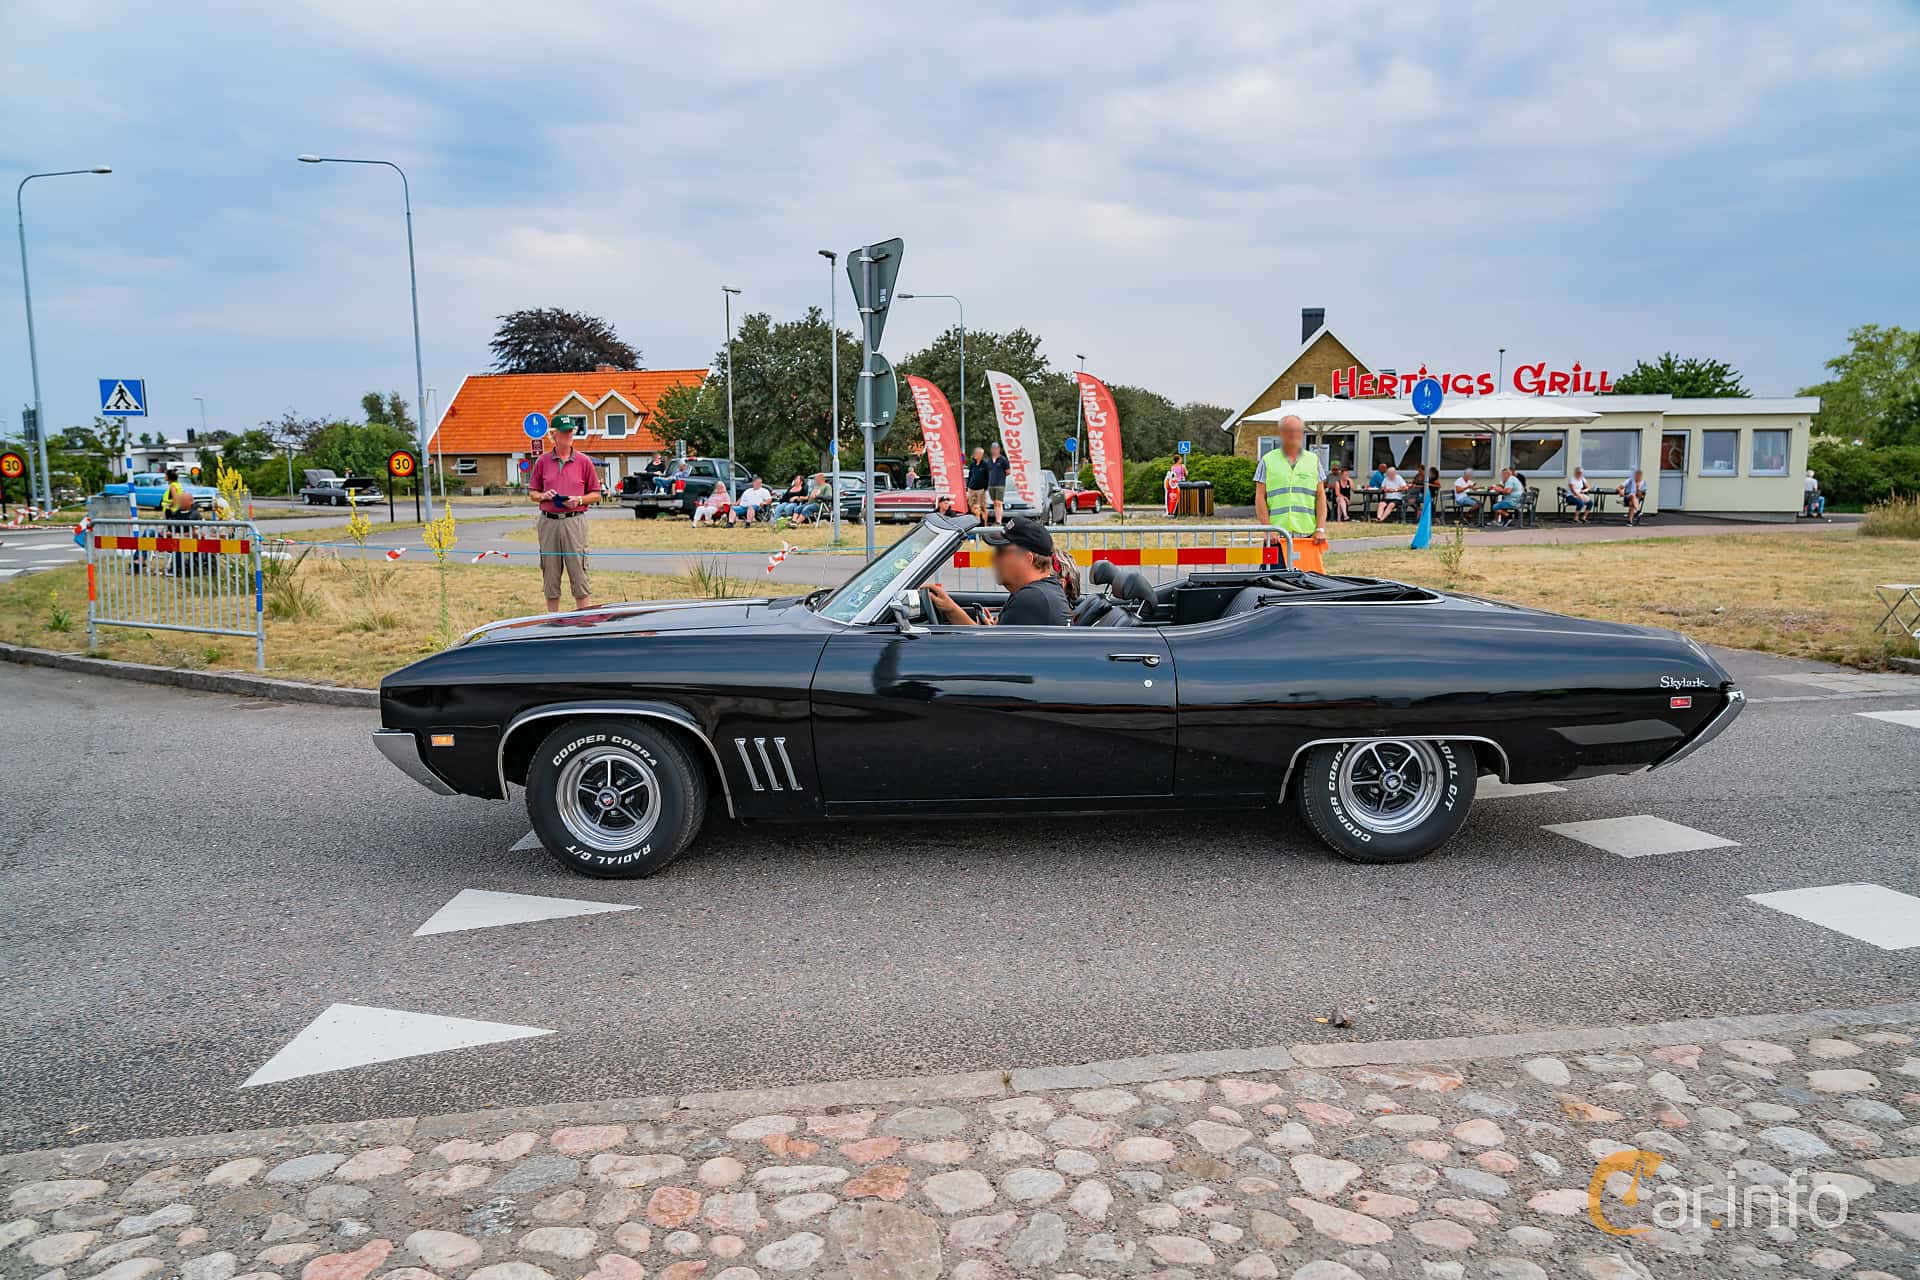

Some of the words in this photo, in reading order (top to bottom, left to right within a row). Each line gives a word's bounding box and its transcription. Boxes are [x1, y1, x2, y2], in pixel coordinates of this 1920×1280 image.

[4, 460, 20, 472] 30
[394, 458, 410, 470] 30
[1660, 675, 1710, 690] Skylark
[552, 734, 606, 767] COOPER
[611, 735, 658, 767] COBRA
[1328, 743, 1350, 791] COBRA
[1330, 796, 1372, 842] COOPER
[566, 845, 593, 861] G/T
[597, 844, 651, 864] RADIAL
